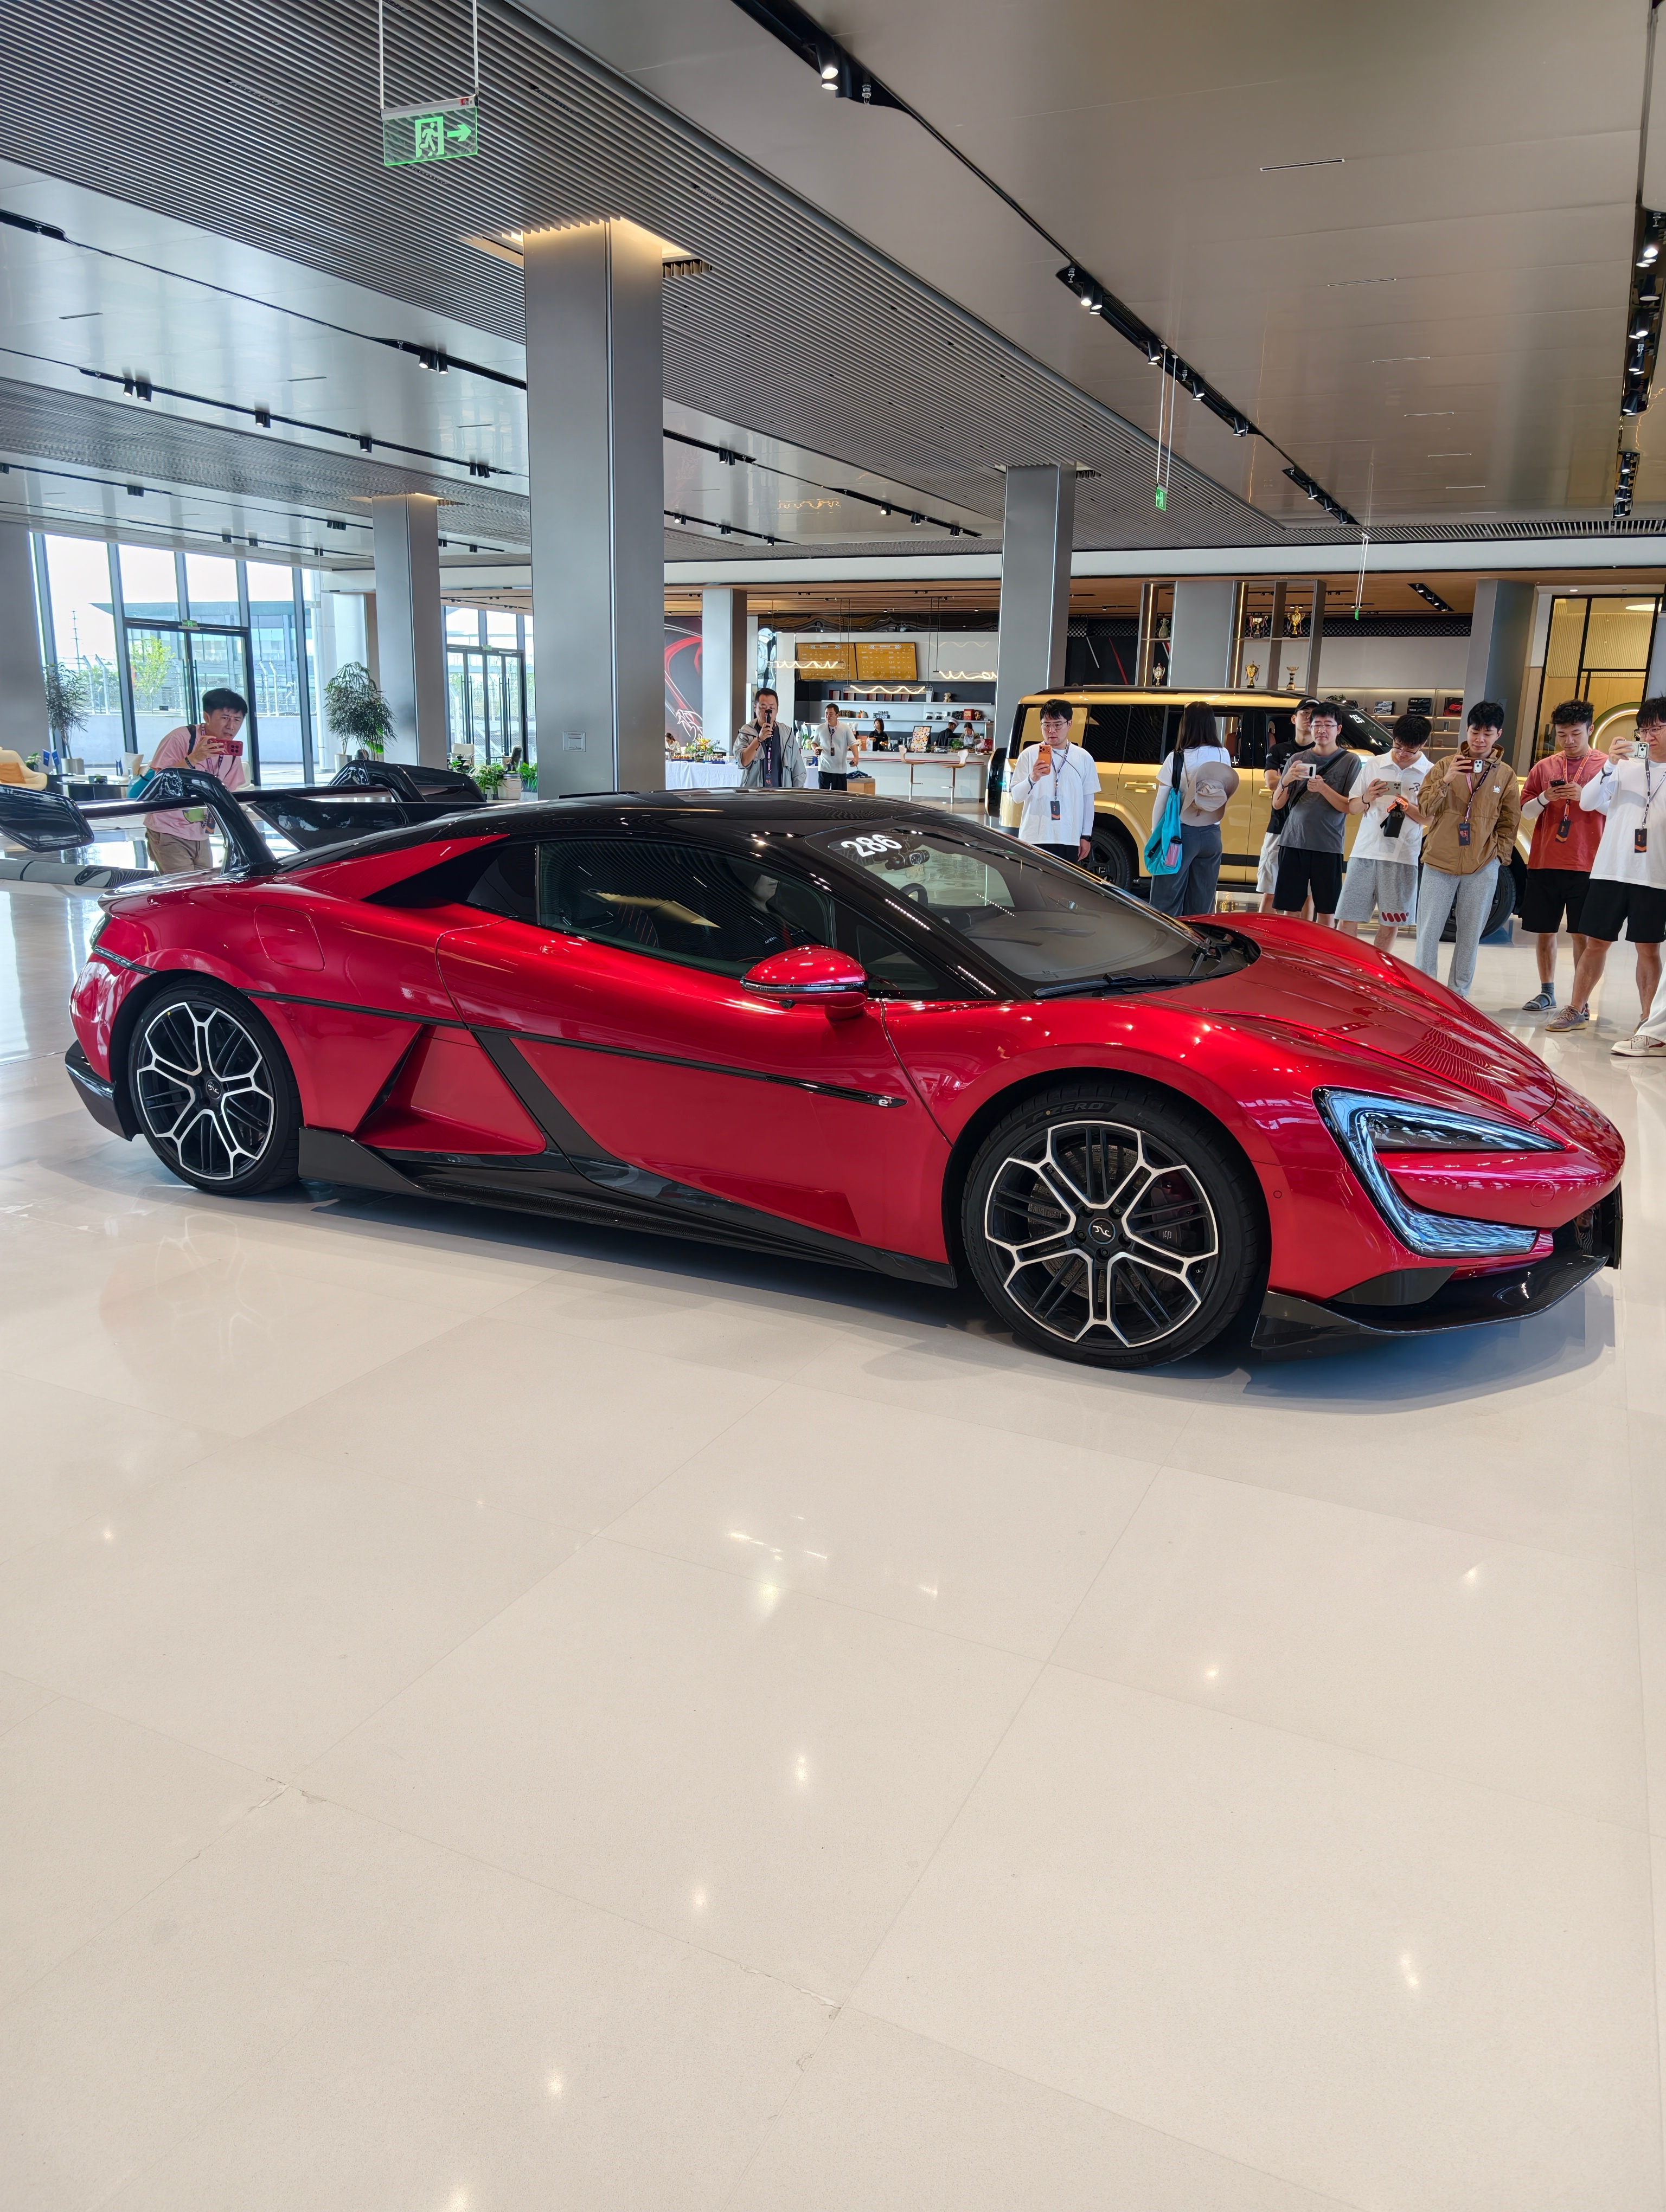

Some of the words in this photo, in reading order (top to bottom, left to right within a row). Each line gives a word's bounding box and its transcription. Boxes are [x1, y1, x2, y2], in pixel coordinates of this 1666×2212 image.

[841, 834, 902, 857] 286
[1032, 1112, 1045, 1123] P
[1050, 1103, 1105, 1115] ZERO
